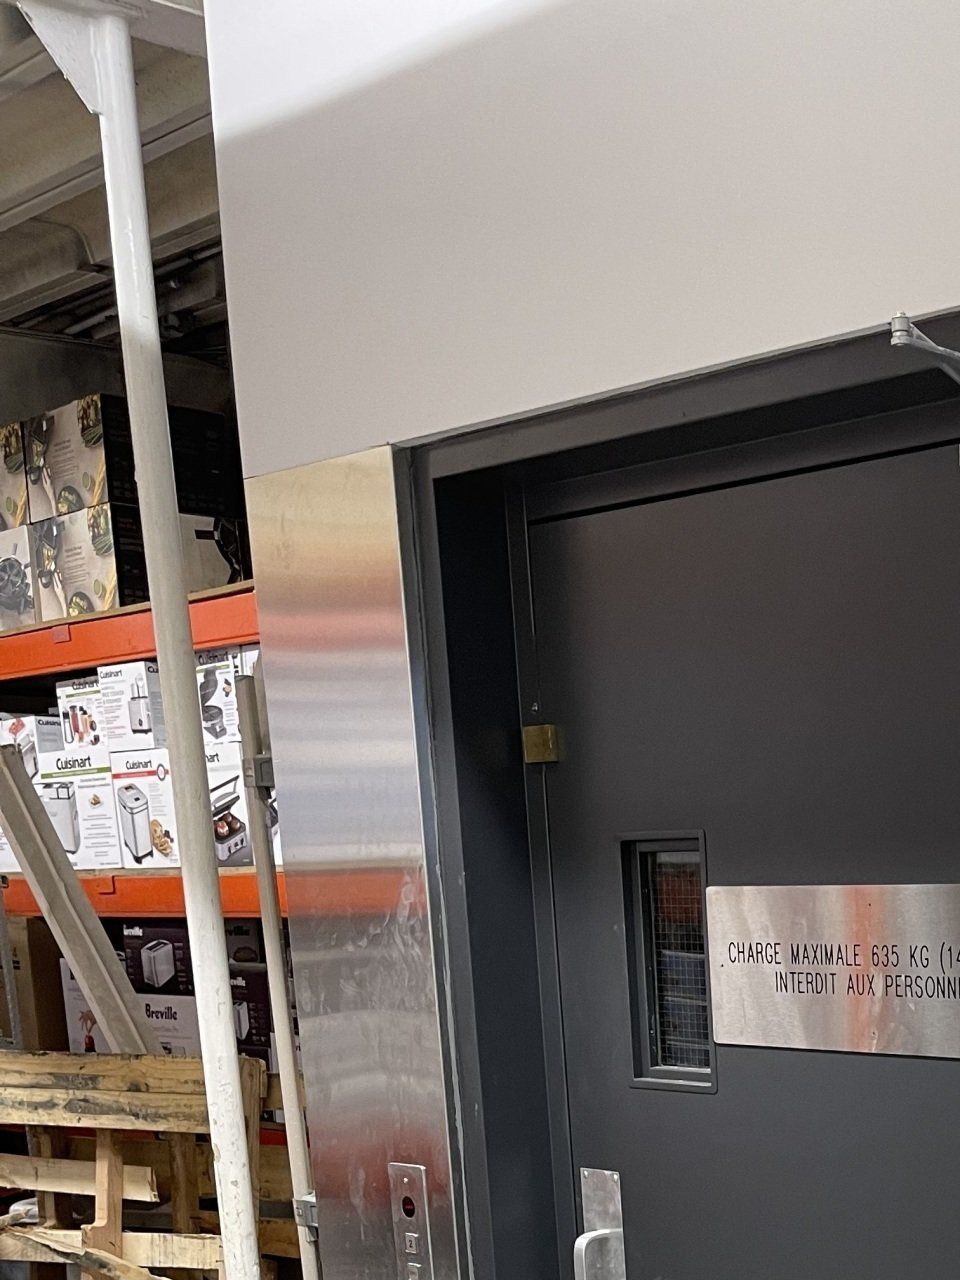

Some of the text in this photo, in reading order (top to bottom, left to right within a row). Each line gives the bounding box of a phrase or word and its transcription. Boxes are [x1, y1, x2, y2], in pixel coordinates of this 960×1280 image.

[100, 669, 123, 679] Cuisinart
[56, 756, 92, 770] Cuisinart
[125, 760, 152, 770] Cuisinart
[728, 942, 782, 965] CHARGE
[791, 942, 862, 967] MAXIMALE
[871, 945, 899, 967] 635
[910, 945, 930, 969] KG
[775, 971, 836, 996] INTERDIT
[847, 974, 876, 997] AUX
[145, 1003, 178, 1021] Breville
